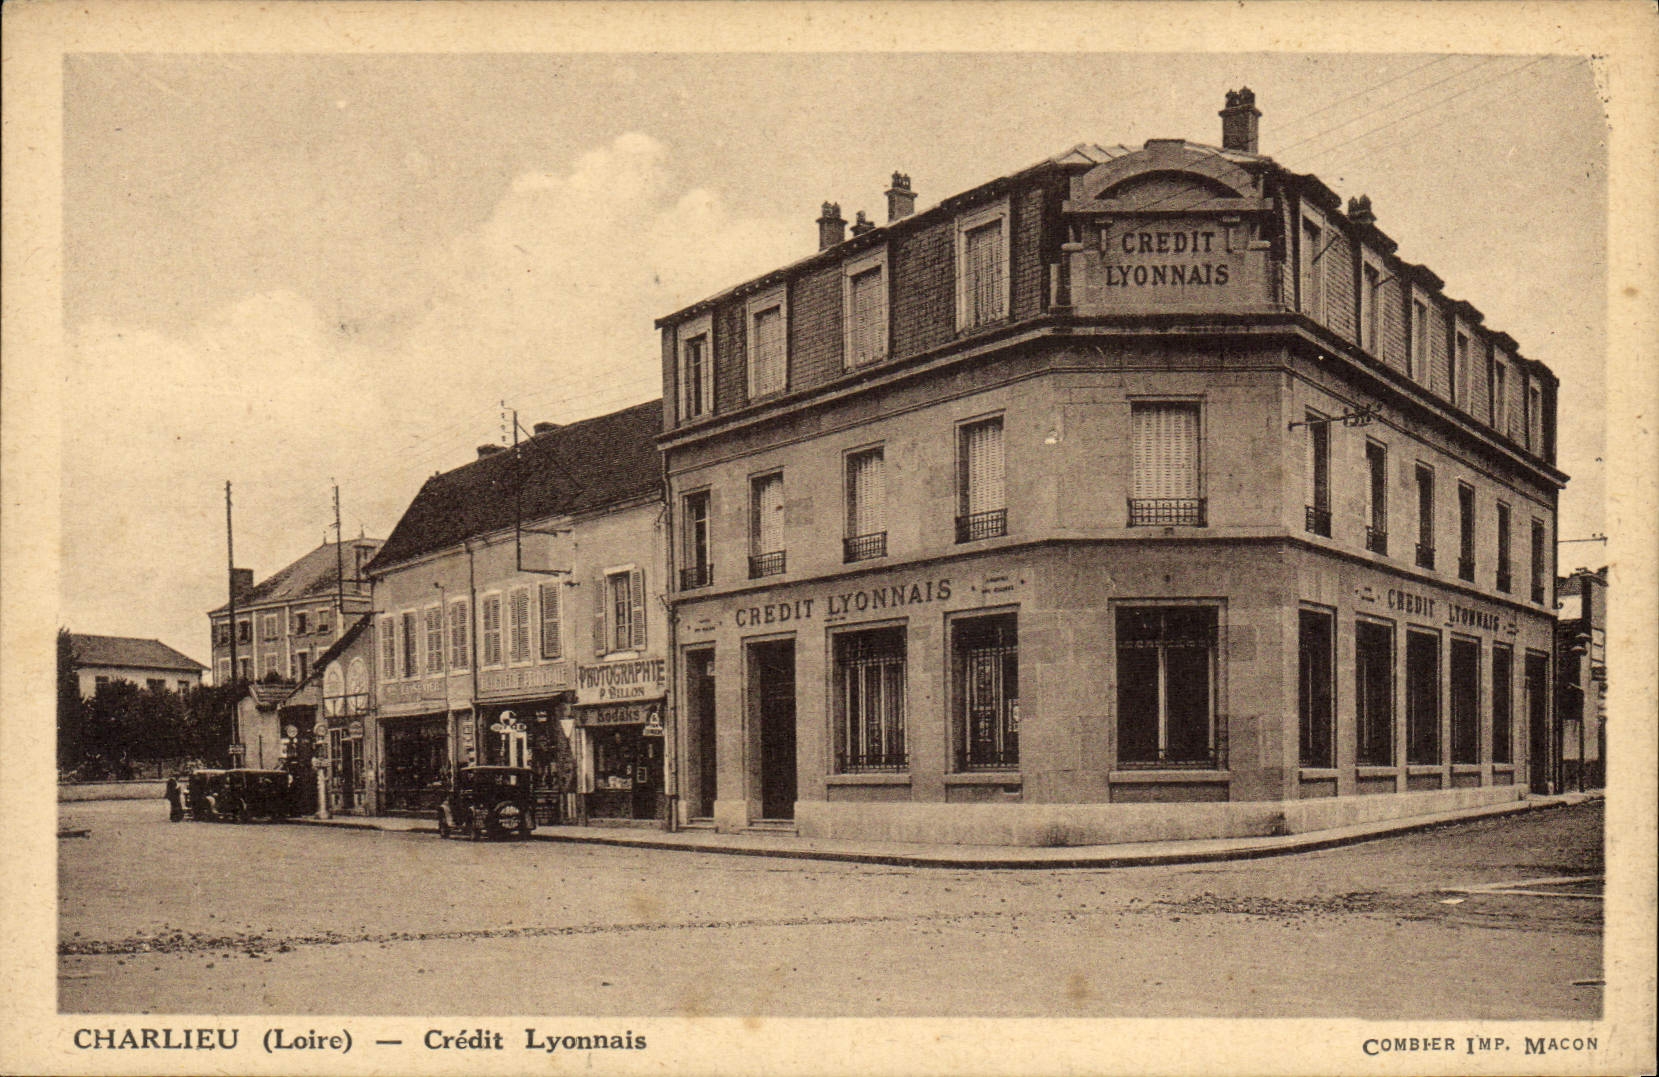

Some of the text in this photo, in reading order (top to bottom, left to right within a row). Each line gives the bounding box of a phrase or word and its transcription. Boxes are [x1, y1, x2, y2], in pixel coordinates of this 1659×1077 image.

[1121, 231, 1216, 254] CREDIT
[1105, 264, 1230, 287] LYONNAIS
[735, 578, 952, 628] CREDIT LYONNAIS
[1387, 588, 1500, 632] CREDIT LYONNAIS
[578, 659, 666, 689] PHOTOGRAPHIE
